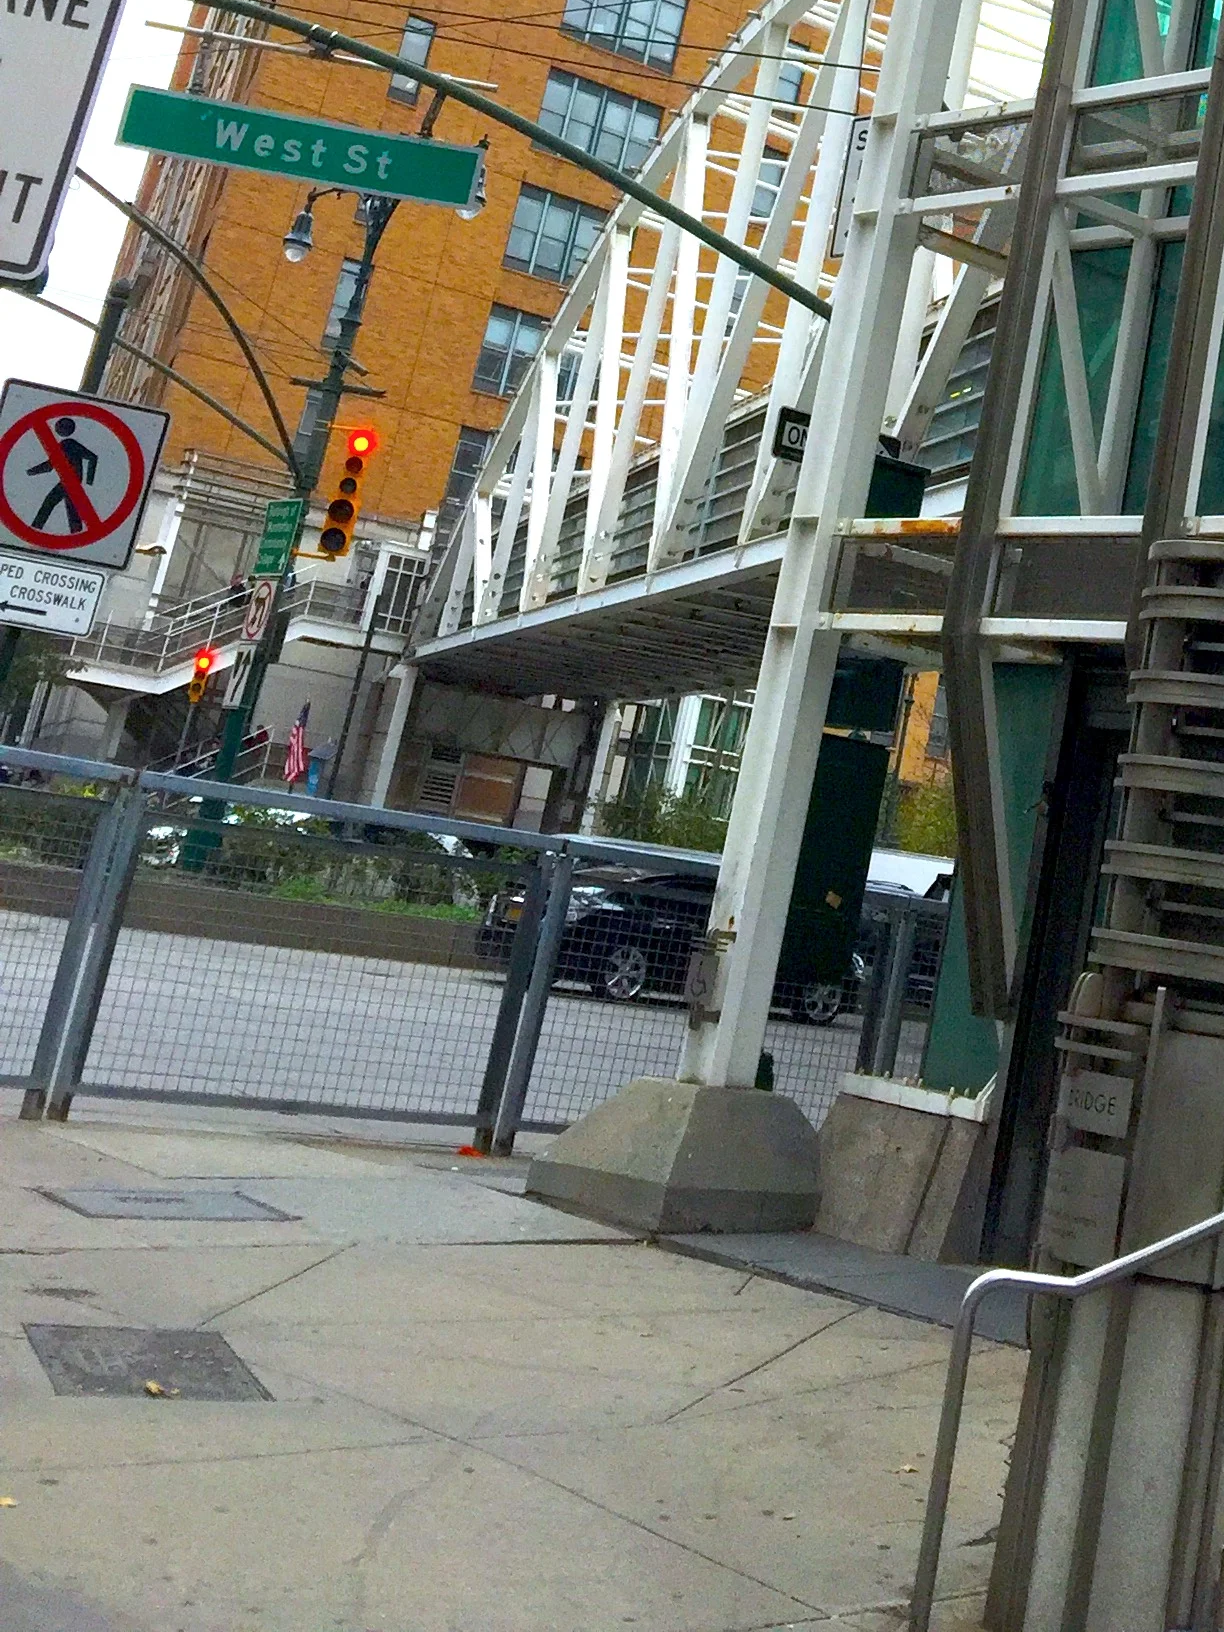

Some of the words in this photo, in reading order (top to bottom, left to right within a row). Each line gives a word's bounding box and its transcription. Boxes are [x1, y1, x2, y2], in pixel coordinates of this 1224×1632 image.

[215, 119, 328, 168] West
[342, 144, 393, 180] St
[33, 570, 97, 594] CROSSING
[10, 585, 87, 611] CROSSWALK
